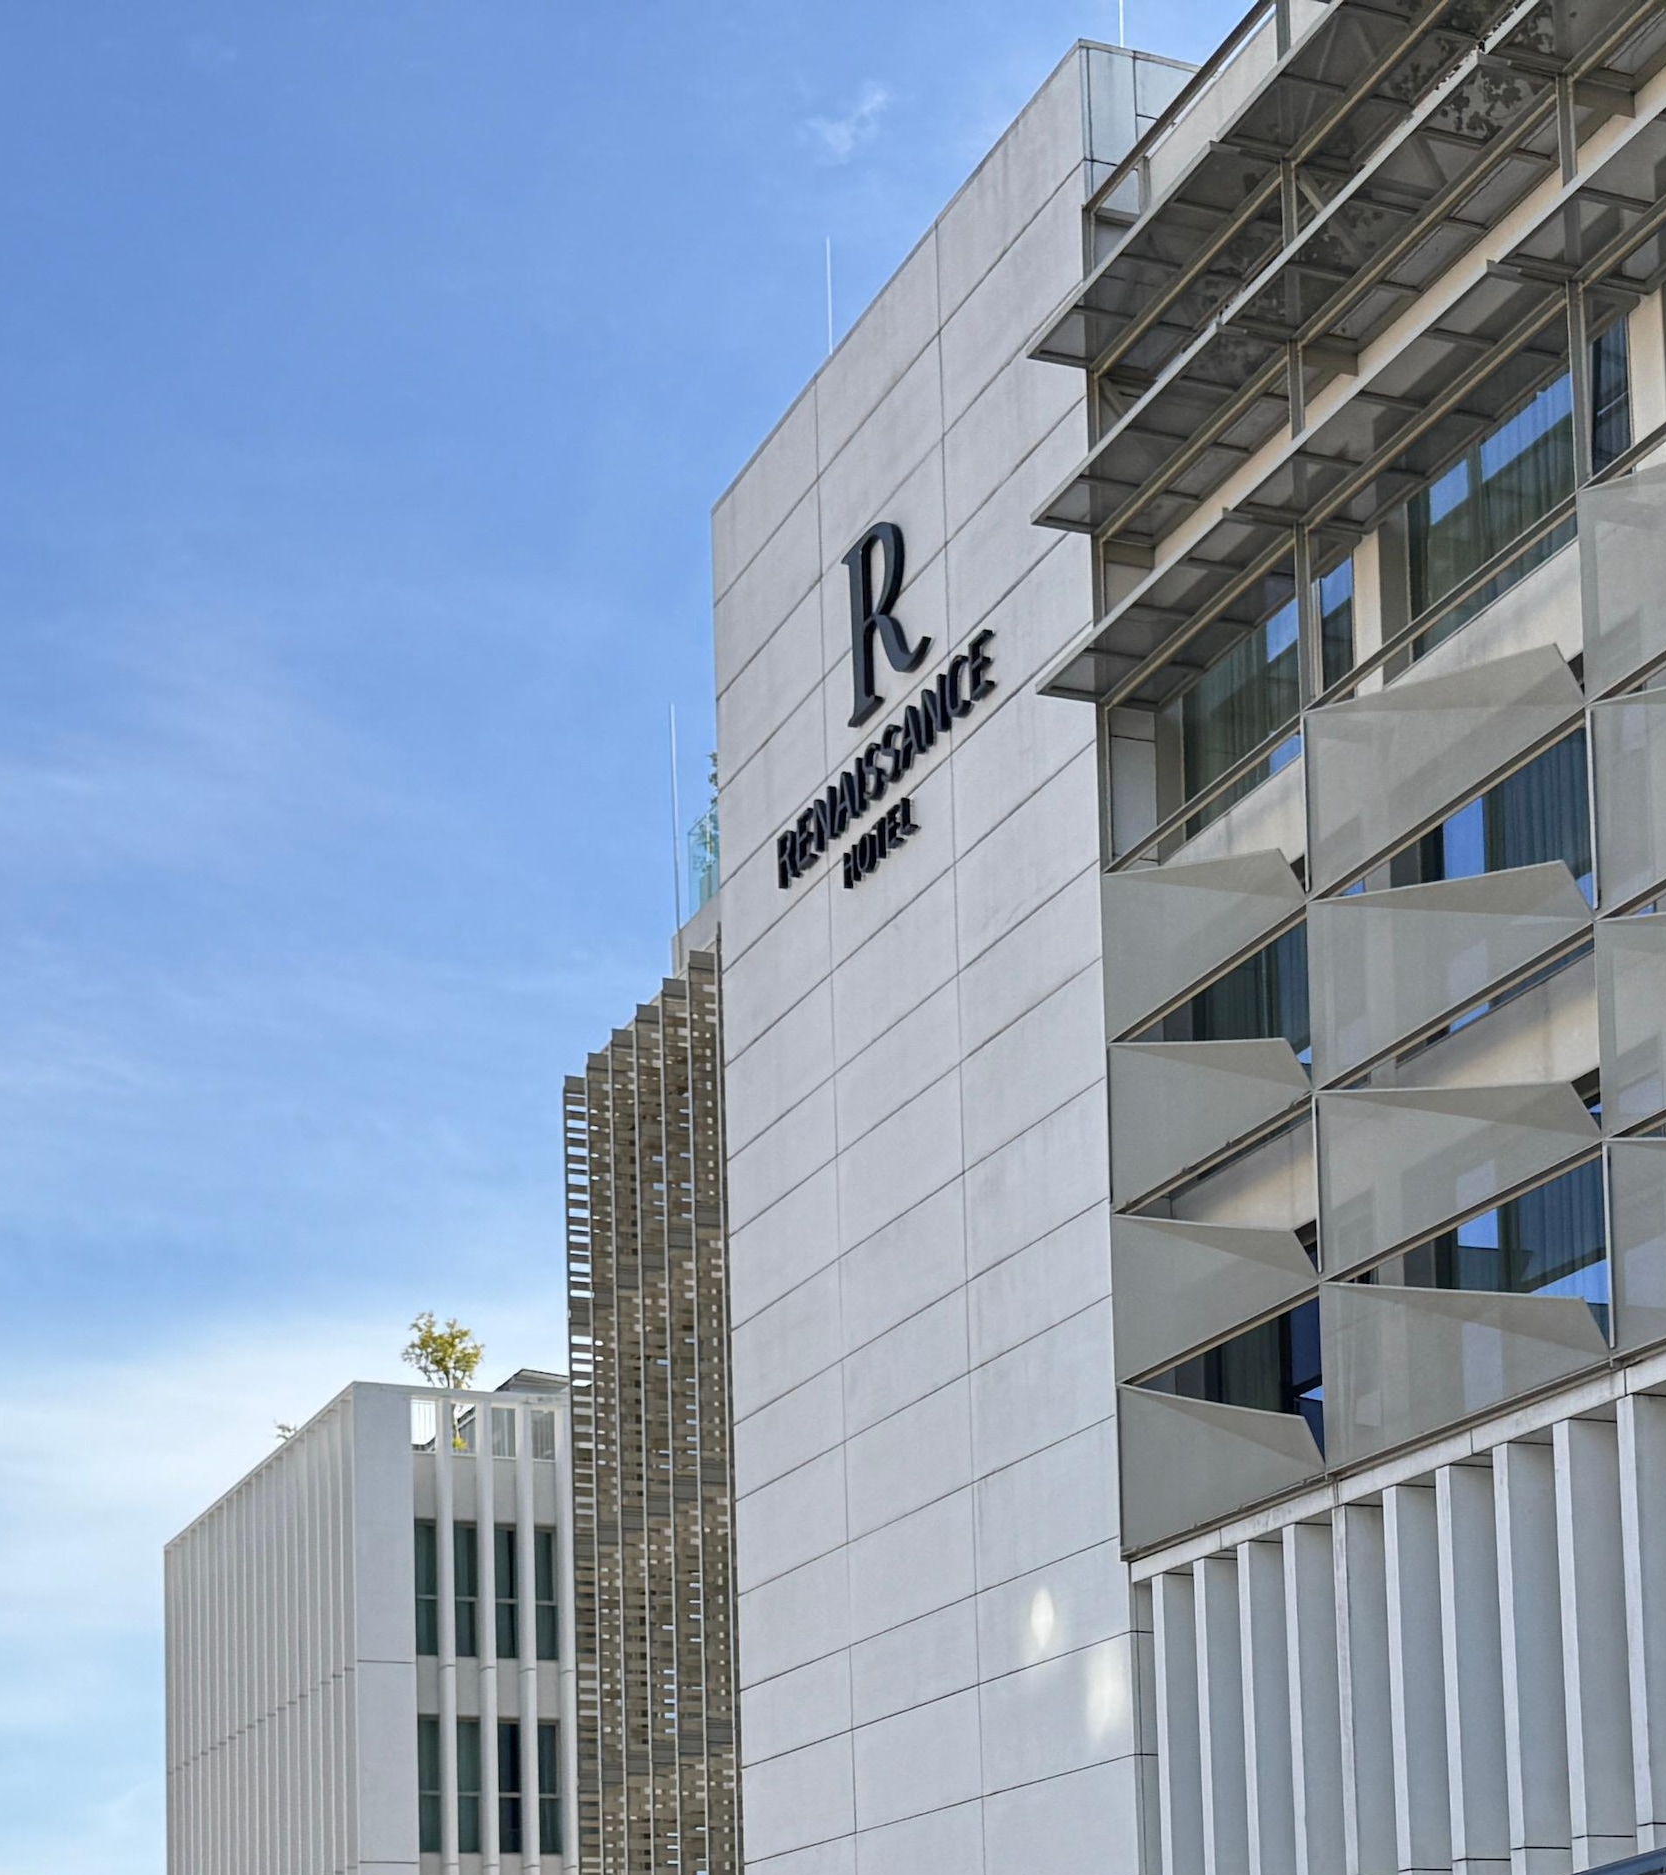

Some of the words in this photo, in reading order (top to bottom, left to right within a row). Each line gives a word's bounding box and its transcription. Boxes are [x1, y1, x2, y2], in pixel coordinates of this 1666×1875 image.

[841, 521, 932, 728] R
[777, 629, 997, 889] RENAISSANCE
[843, 797, 921, 889] HOTEL
